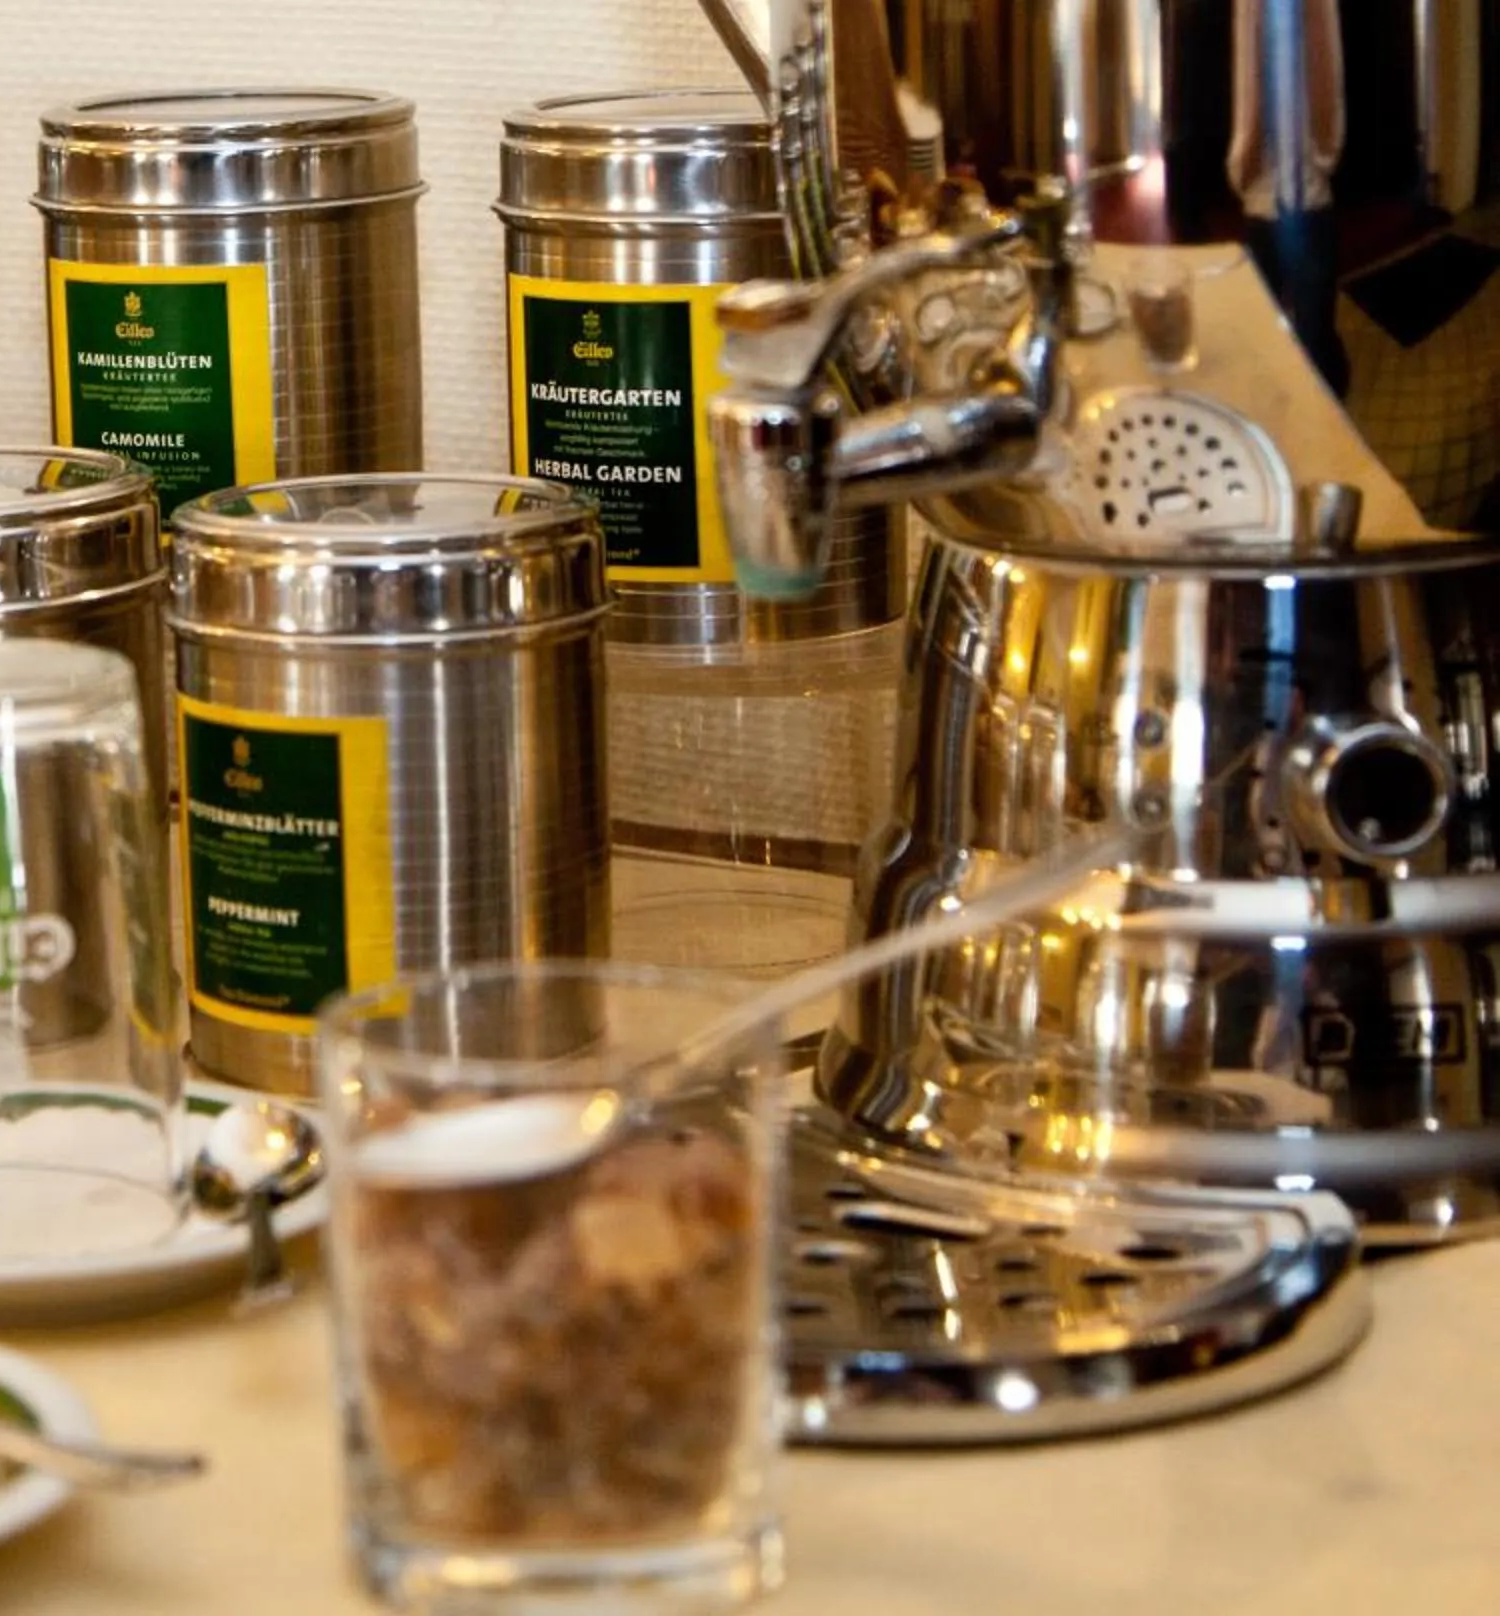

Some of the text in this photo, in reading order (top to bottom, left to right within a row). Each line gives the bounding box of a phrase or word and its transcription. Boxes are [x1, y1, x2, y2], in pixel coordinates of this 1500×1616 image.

[78, 351, 213, 369] KAMILLENBLÜTEN
[531, 380, 682, 407] KRÄUTERGARTEN
[101, 431, 185, 448] CAMOMILE
[535, 458, 682, 483] HERBAL GARDEN
[208, 895, 300, 927] PEPPERMINT
